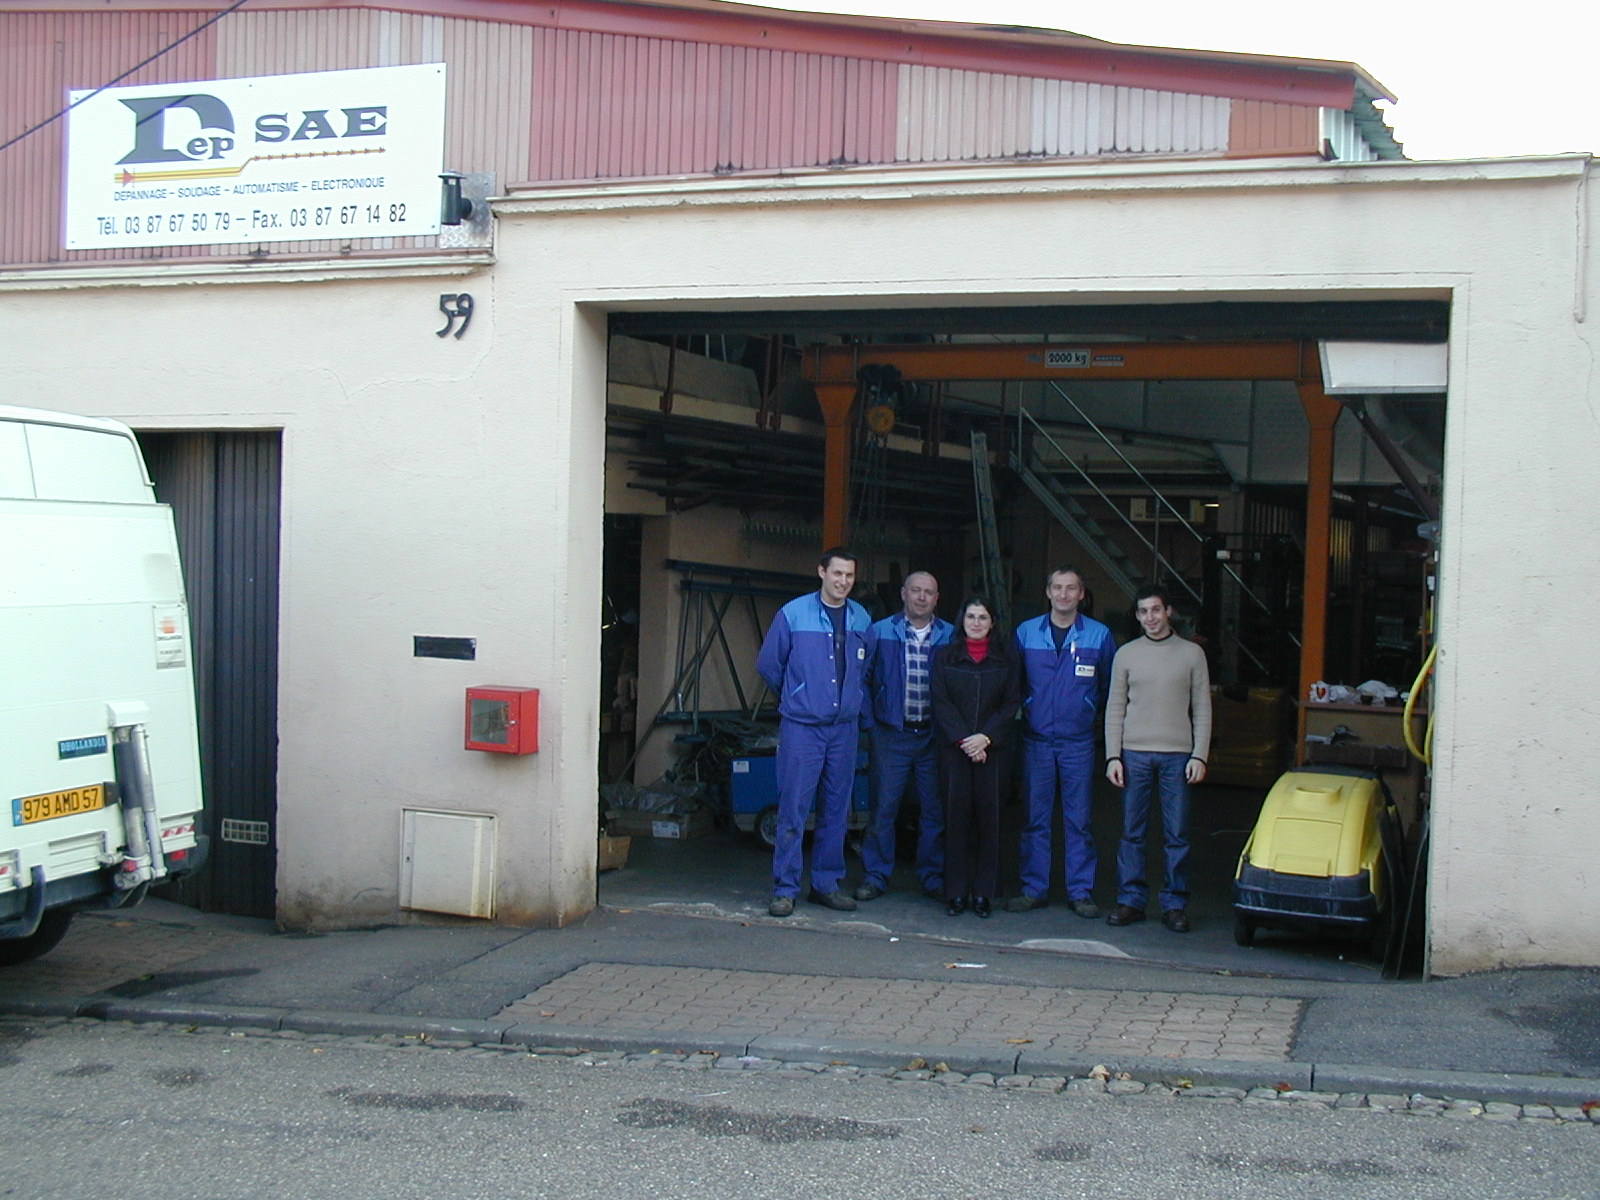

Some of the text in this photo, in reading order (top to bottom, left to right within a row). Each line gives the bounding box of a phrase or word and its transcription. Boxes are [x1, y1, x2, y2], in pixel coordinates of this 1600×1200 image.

[255, 106, 387, 143] SAE
[113, 188, 167, 201] DEPANNAGE
[177, 185, 221, 198] SOUDAGE
[232, 181, 299, 195] AUTOMATISME
[311, 176, 385, 191] ELECTRONIQUE
[97, 215, 118, 236] Tél.
[124, 216, 140, 234] 03
[146, 214, 162, 233] 87
[169, 213, 185, 232] 67
[191, 212, 208, 231] 50
[214, 211, 230, 230] 79
[252, 209, 283, 229] Fax.
[290, 208, 307, 227] 03
[315, 206, 332, 226] 87
[340, 205, 358, 224] 67
[366, 204, 381, 223] 14
[389, 202, 407, 222] 82
[436, 292, 474, 339] 59
[1049, 352, 1072, 364] 2000
[1074, 352, 1087, 364] kg
[23, 787, 98, 820] 979 AMD 57
